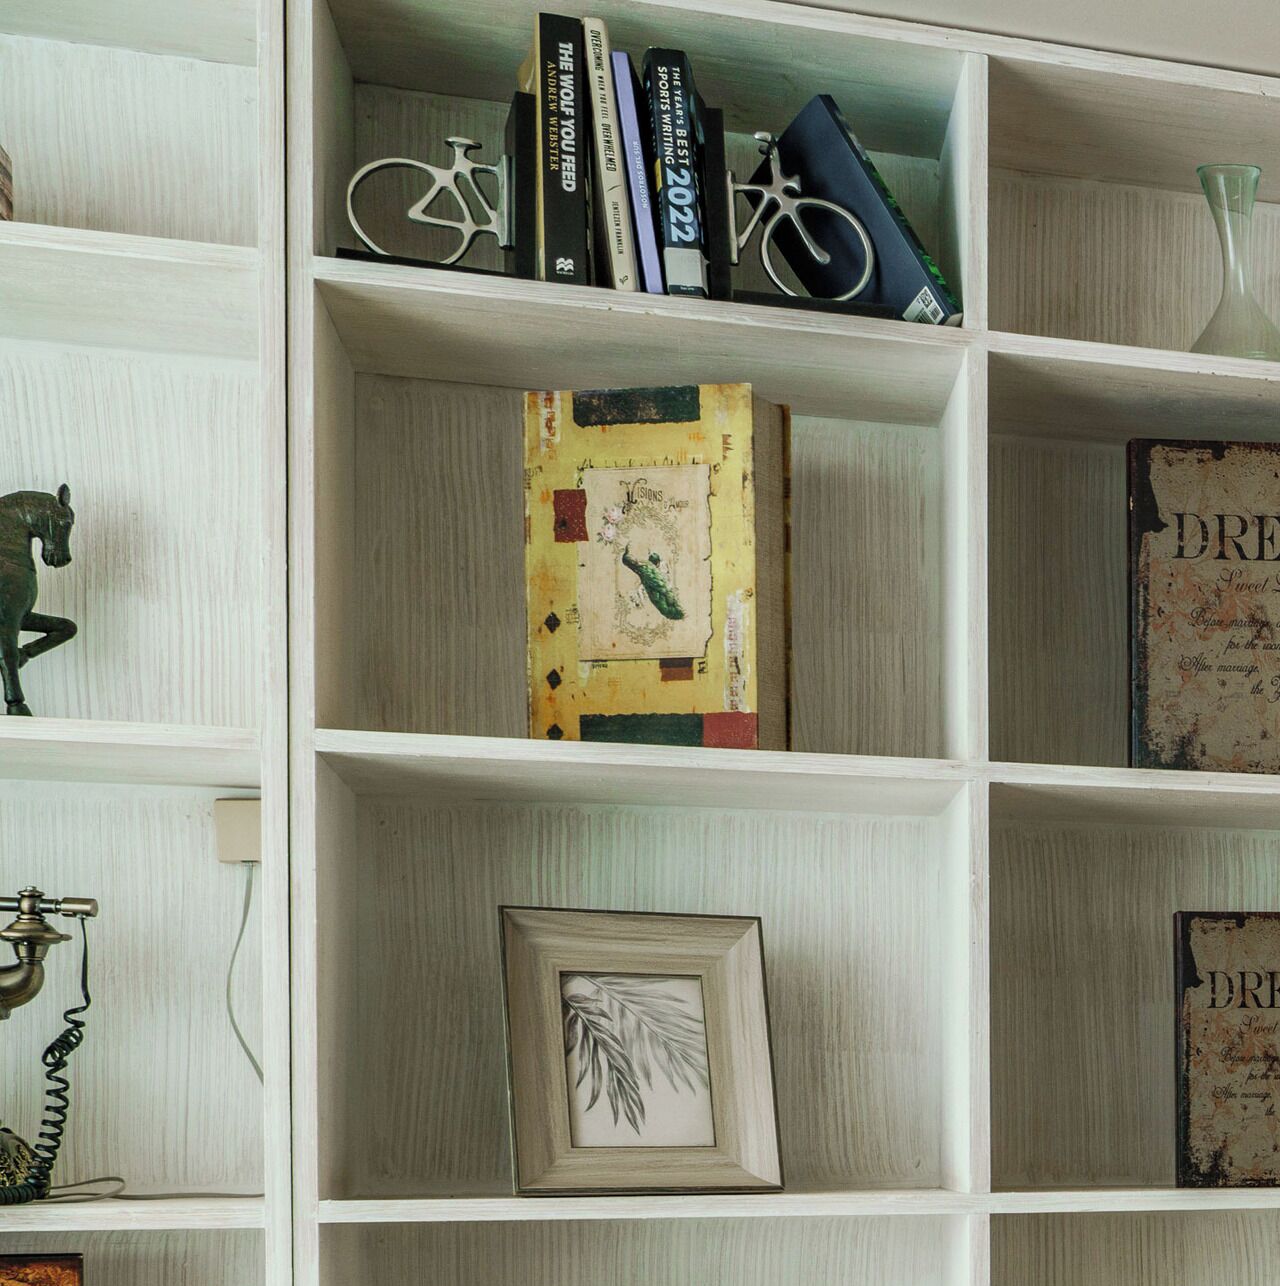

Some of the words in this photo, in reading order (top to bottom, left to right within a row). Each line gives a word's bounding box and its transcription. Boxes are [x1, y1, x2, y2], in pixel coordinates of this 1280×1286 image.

[559, 42, 573, 72] THE
[672, 66, 682, 86] THE
[547, 61, 558, 112] ANDREW
[560, 74, 575, 116] WOLF
[590, 29, 604, 72] OVERCOMING
[601, 123, 617, 172] OVERWHELMED
[657, 66, 671, 111] SPORTS
[673, 89, 684, 125] YEAR'S
[549, 117, 559, 171] WEBSTER
[560, 118, 576, 152] YOU
[660, 113, 675, 165] WRITING
[675, 128, 690, 167] BEST
[561, 155, 576, 192] FEED
[637, 170, 648, 209] NOSOTROS
[666, 167, 696, 242] 2022
[615, 228, 624, 255] FRANKLIN
[1216, 568, 1269, 594] Sweet
[1239, 1014, 1278, 1035] Sweet
